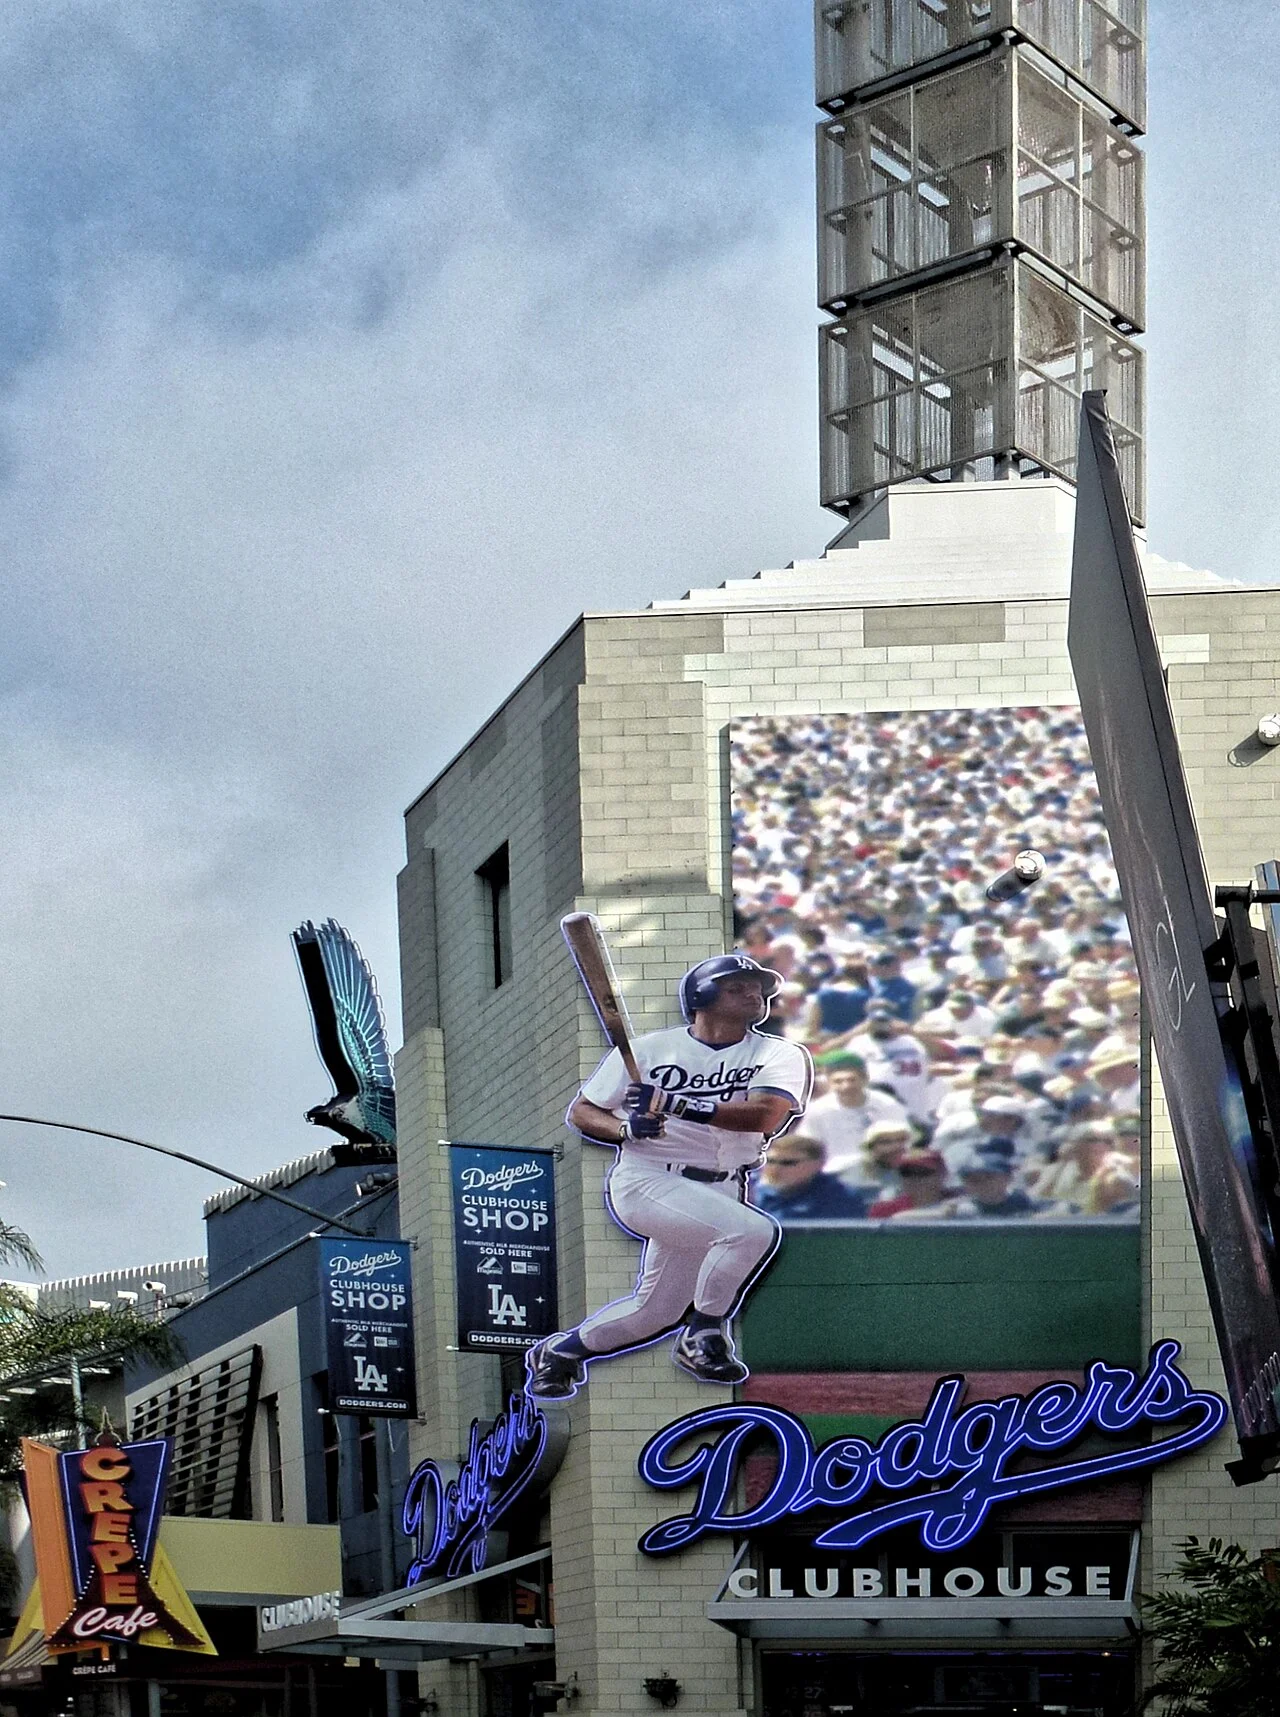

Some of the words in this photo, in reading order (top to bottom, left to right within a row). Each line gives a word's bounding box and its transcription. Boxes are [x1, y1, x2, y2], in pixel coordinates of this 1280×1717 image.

[461, 1160, 544, 1191] Dodgers
[462, 1195, 548, 1211] CLUBHOUSE
[463, 1207, 549, 1232] SHOP
[329, 1249, 402, 1277] Dodgers
[480, 1247, 505, 1256] SOLD
[508, 1249, 533, 1258] HERE
[330, 1280, 405, 1293] CLUBHOUSE
[331, 1290, 407, 1311] SHOP
[488, 1284, 527, 1327] LA
[471, 1334, 541, 1345] DODGERS.CO
[353, 1355, 388, 1392] LA
[339, 1399, 407, 1409] DODGERS.COM
[639, 1340, 1227, 1555] Dodgers
[403, 1388, 547, 1589] Dodgers
[80, 1446, 138, 1605] CREPE
[727, 1566, 1111, 1598] CLUBHOUSE
[73, 1606, 159, 1636] Cafe
[261, 1590, 340, 1632] CLUBHOUSE
